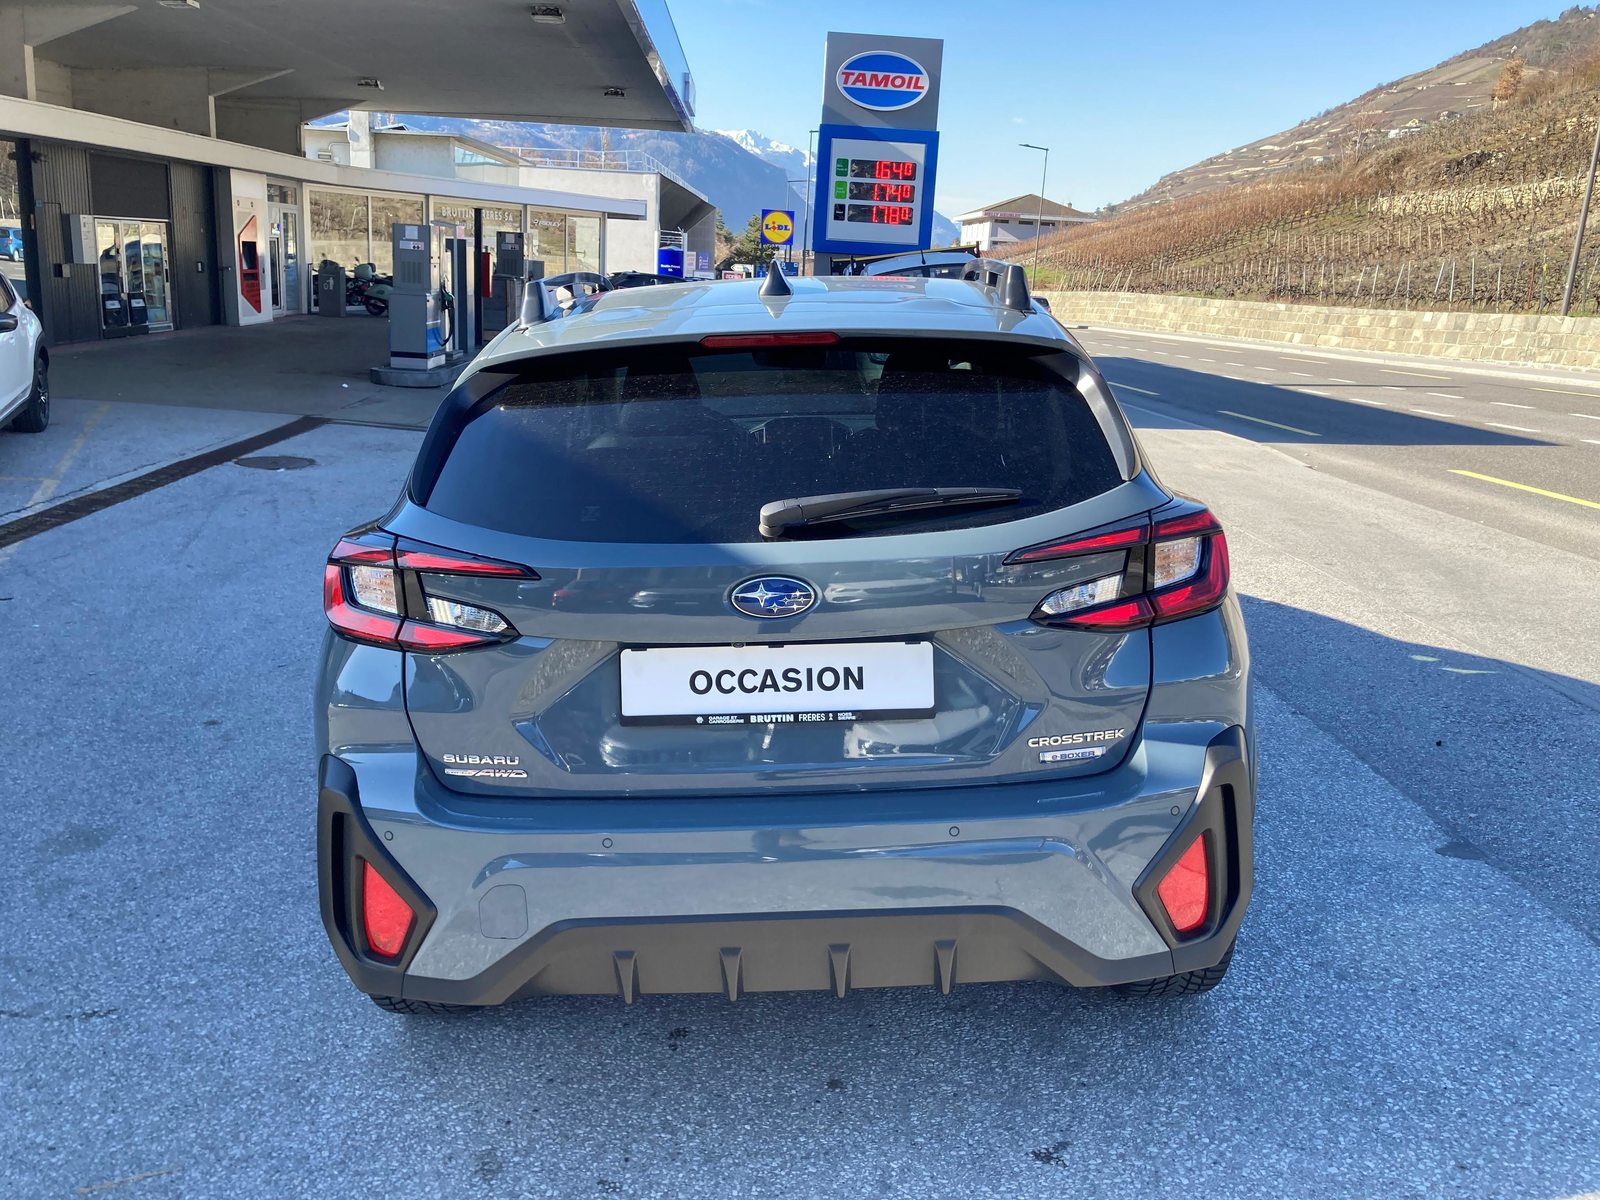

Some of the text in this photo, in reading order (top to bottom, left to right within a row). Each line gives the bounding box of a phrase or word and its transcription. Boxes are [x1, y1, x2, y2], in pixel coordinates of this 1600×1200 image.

[841, 71, 925, 90] TAMOIL
[689, 666, 864, 695] OCCASION
[750, 714, 794, 723] BRUTTIN
[1027, 728, 1125, 748] CROSSTREK
[443, 753, 520, 765] SUBARU
[474, 768, 528, 778] AWD
